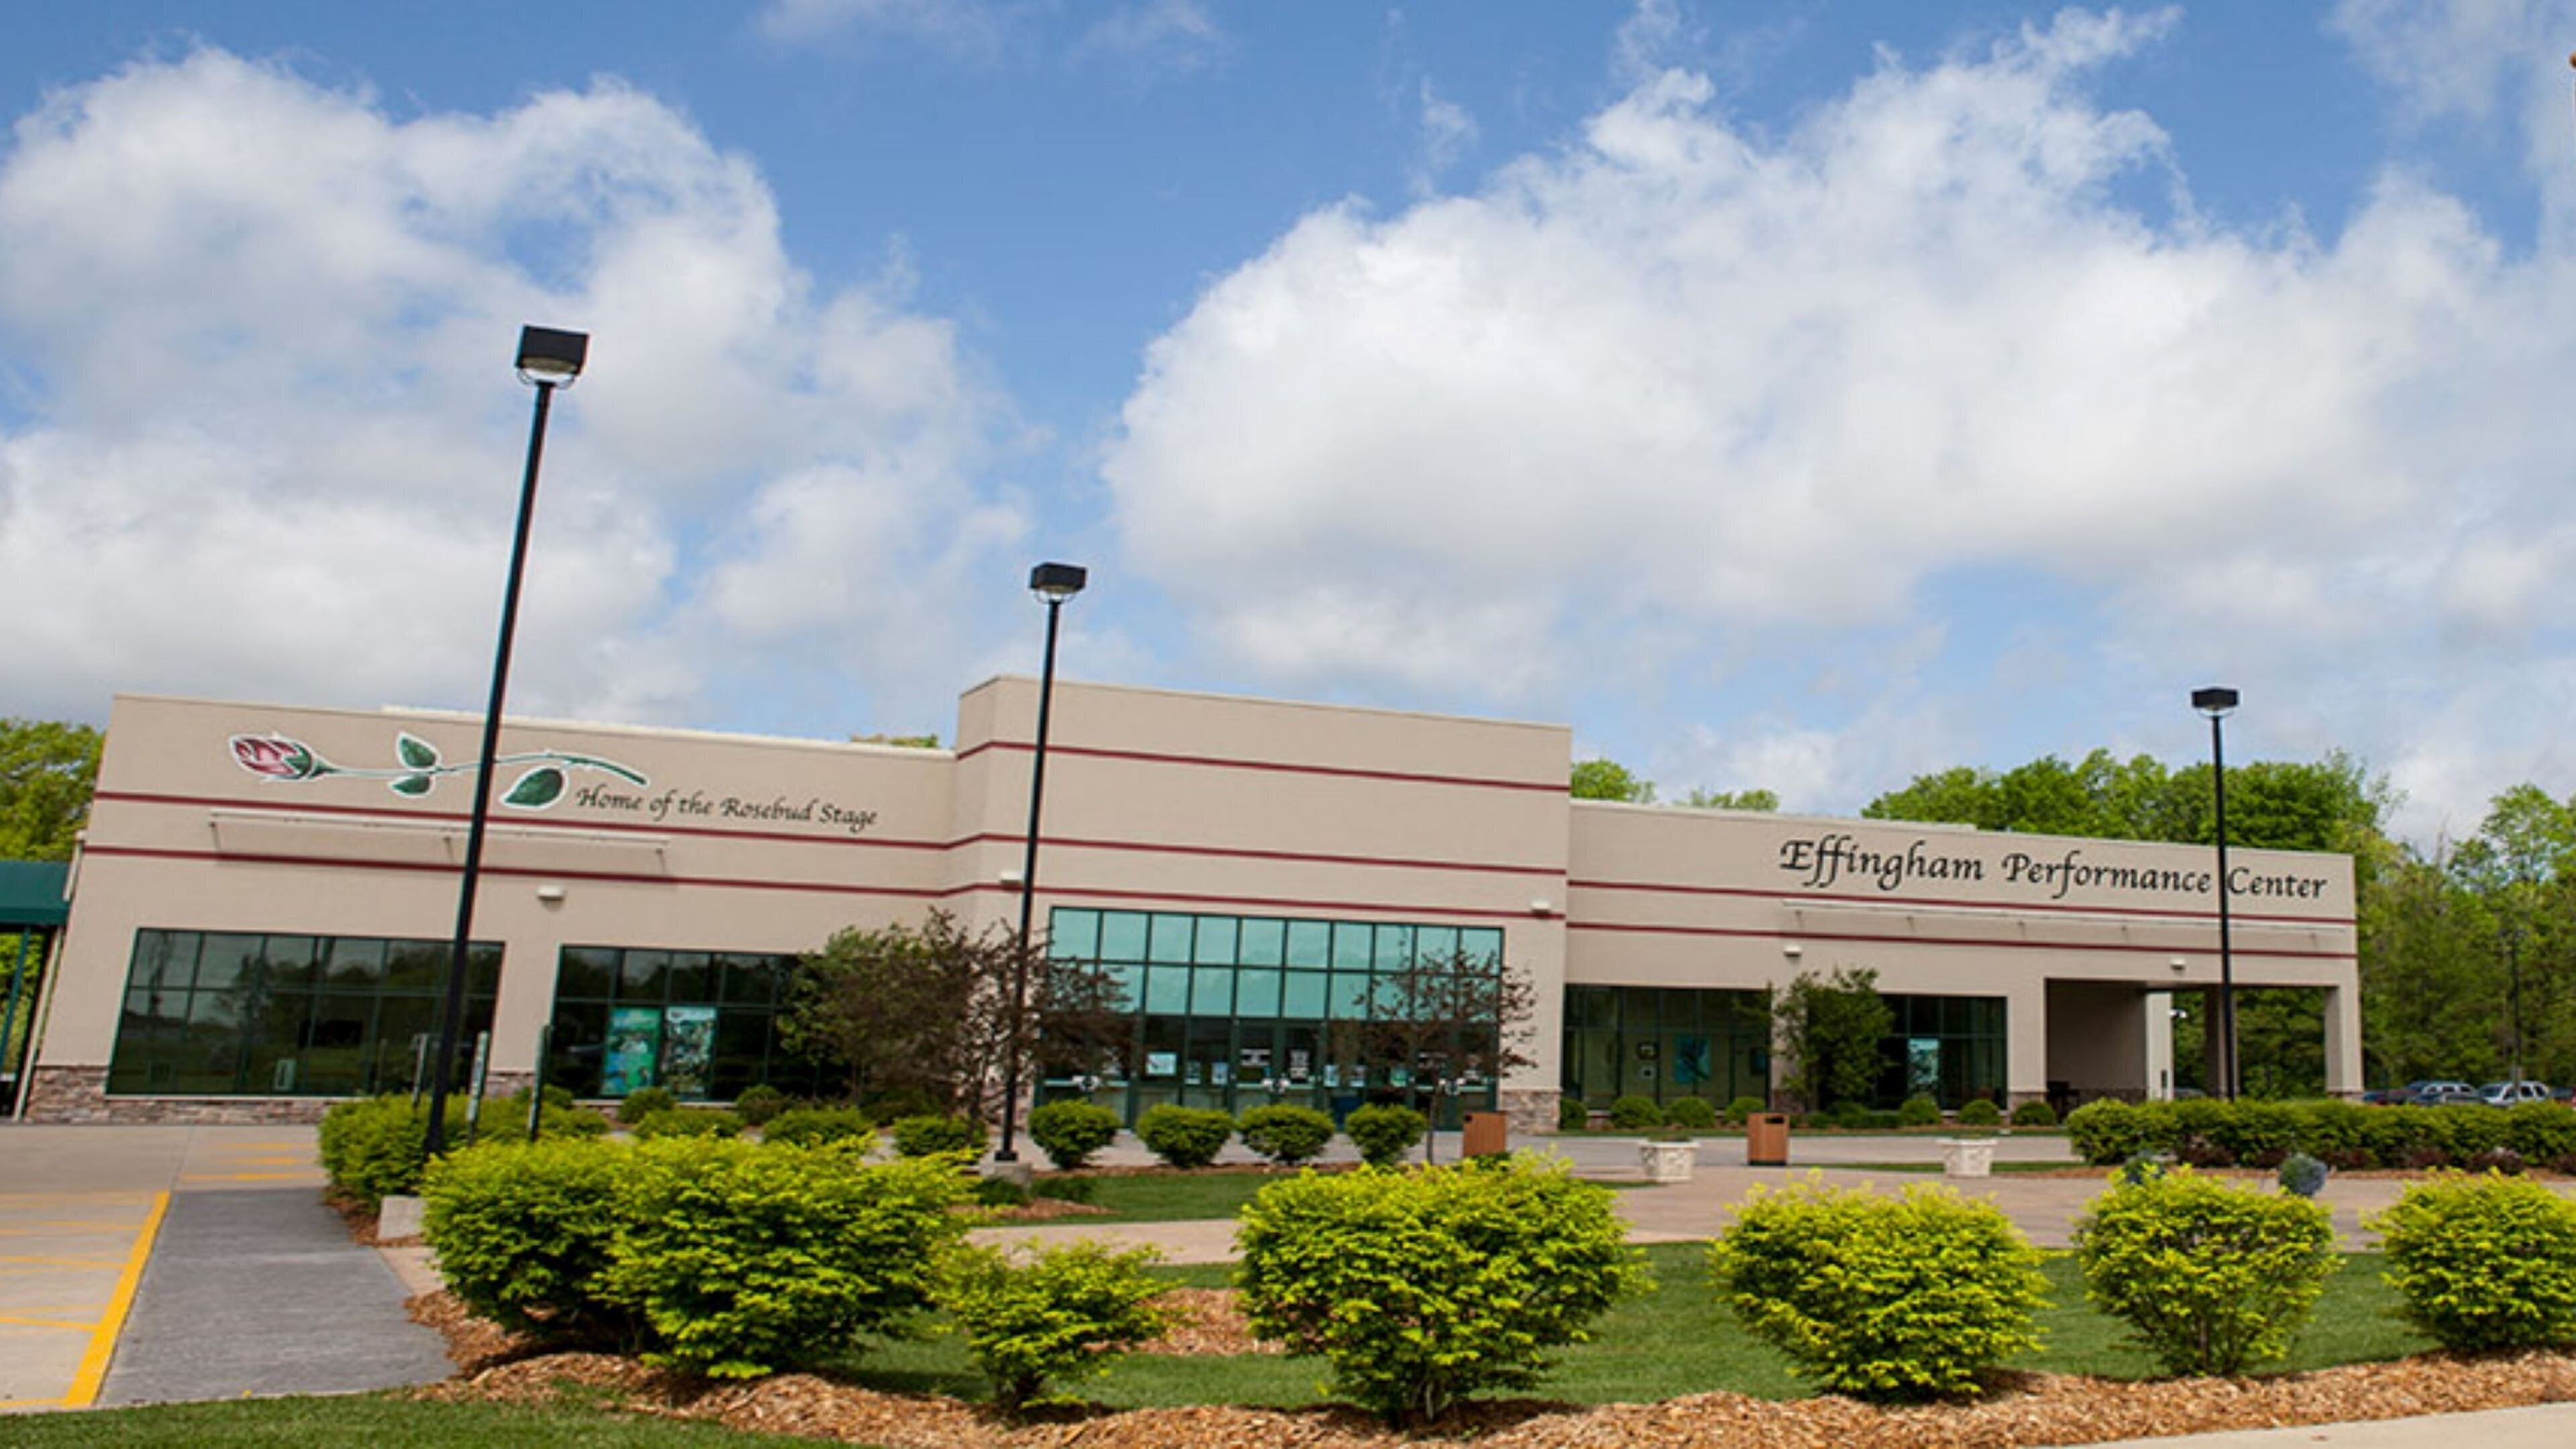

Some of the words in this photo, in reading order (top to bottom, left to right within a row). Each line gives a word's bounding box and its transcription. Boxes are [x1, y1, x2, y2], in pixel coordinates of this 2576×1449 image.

[576, 783, 642, 809] Home
[649, 790, 675, 821] of
[678, 790, 713, 815] the
[720, 794, 816, 824] Rosebud
[818, 802, 878, 833] Stage
[1779, 834, 1984, 891] Effingham
[2000, 850, 2211, 900] Performance
[2226, 867, 2327, 899] Center
